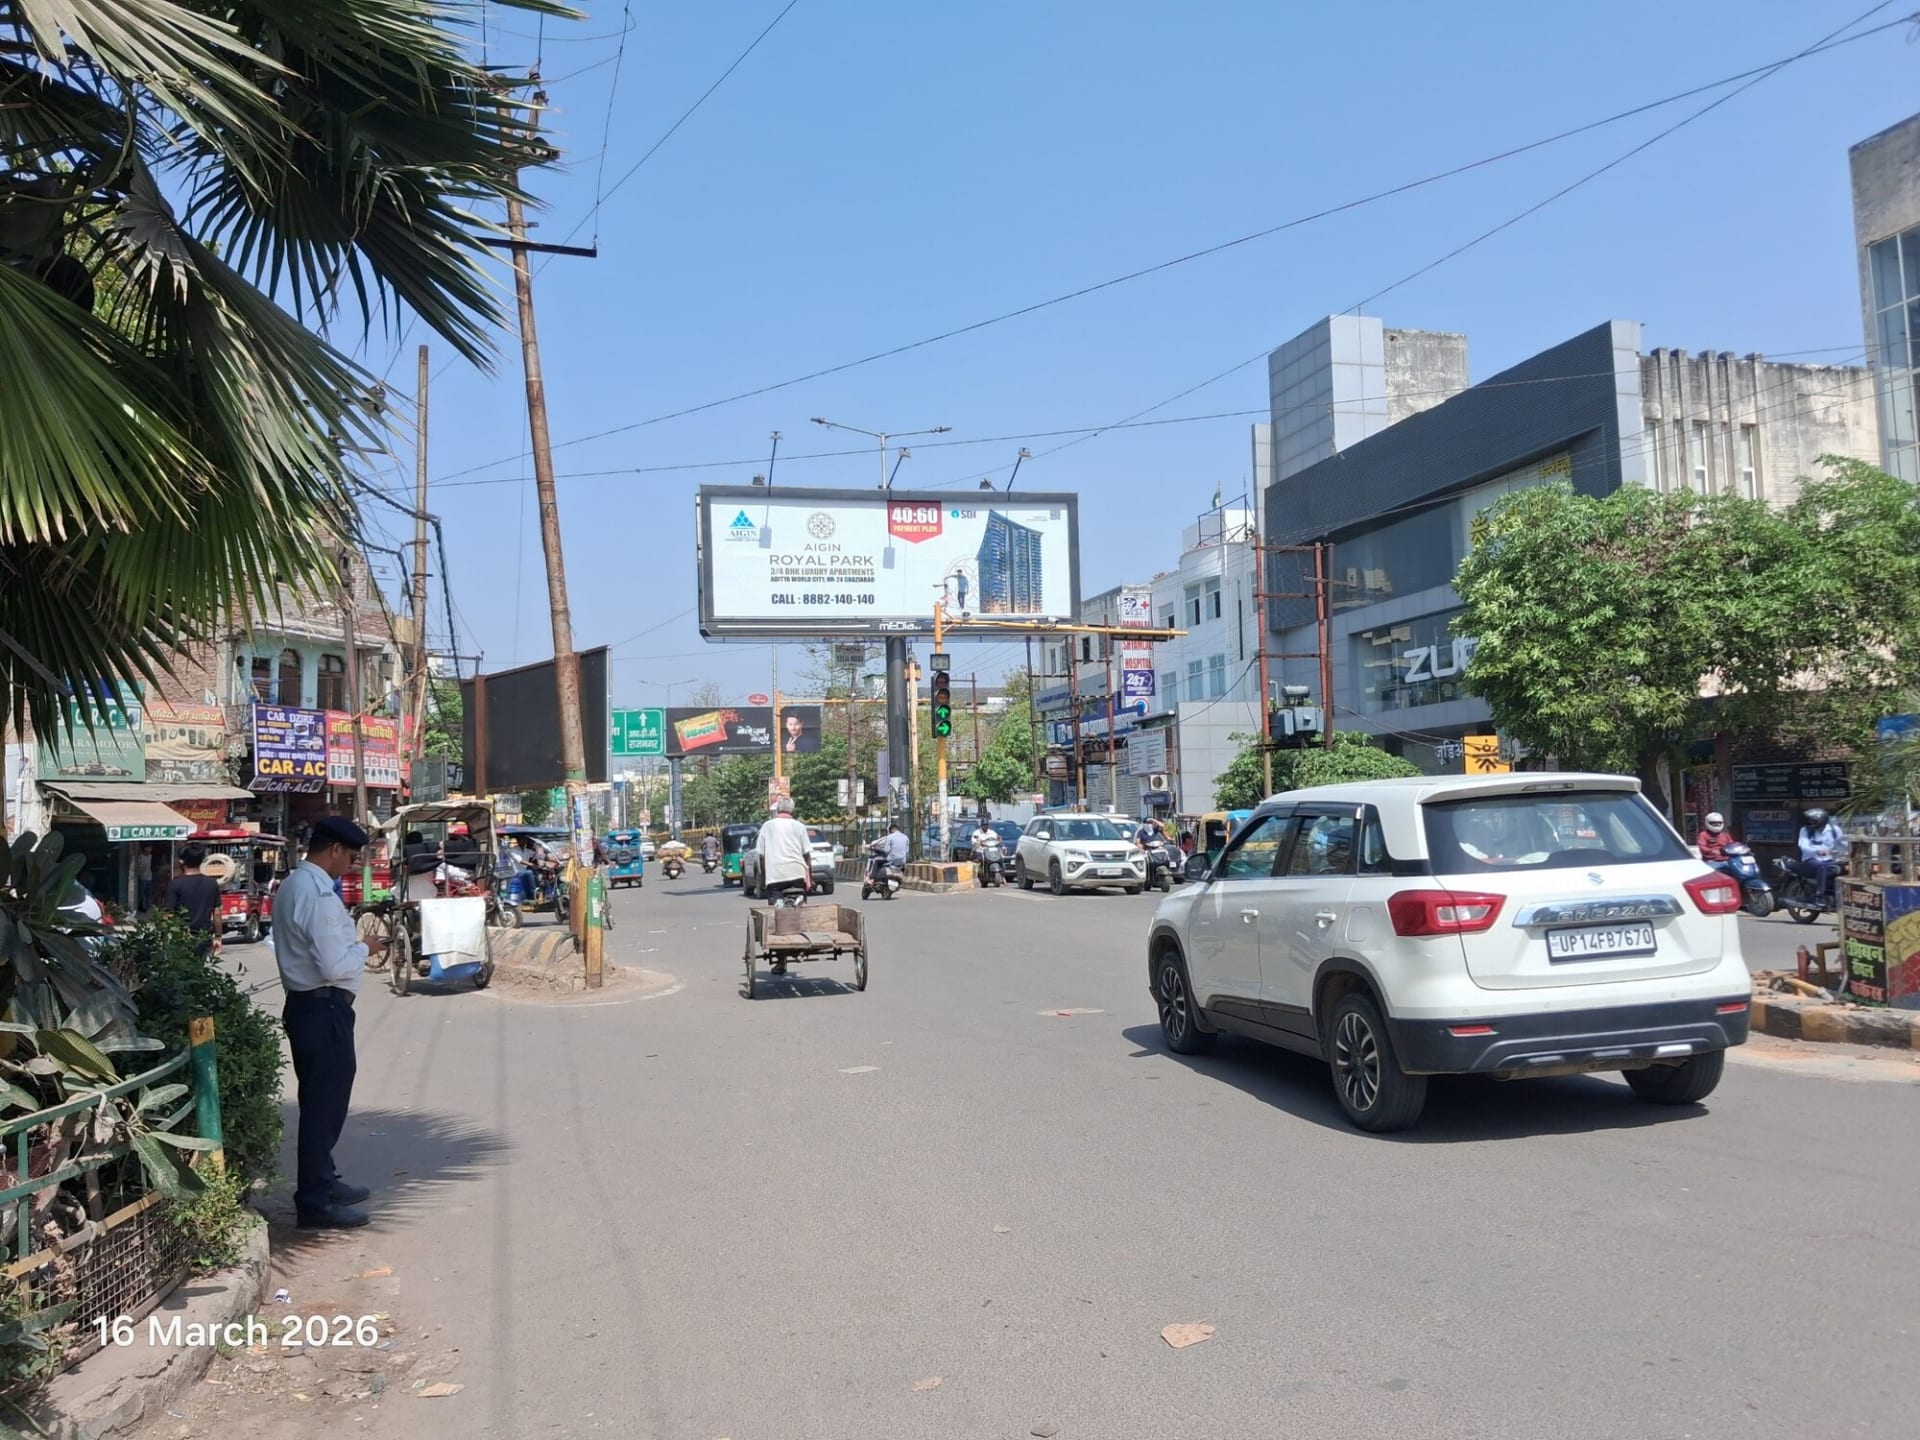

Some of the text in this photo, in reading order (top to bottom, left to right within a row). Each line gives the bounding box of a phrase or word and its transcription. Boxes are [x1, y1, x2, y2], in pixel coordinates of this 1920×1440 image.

[892, 508, 938, 524] 40:60
[961, 511, 976, 519] SBI
[804, 543, 841, 552] AIGIN
[769, 555, 874, 566] ROYAL PARK
[801, 568, 828, 576] LUXURY
[829, 568, 875, 576] APARTMENTS
[771, 594, 795, 604] CALL
[803, 594, 875, 604] 8882-140-140
[266, 710, 286, 722] CAR
[289, 714, 316, 725] DZIRE
[131, 828, 168, 837] CAR AC
[1560, 929, 1652, 953] UP14FB7670
